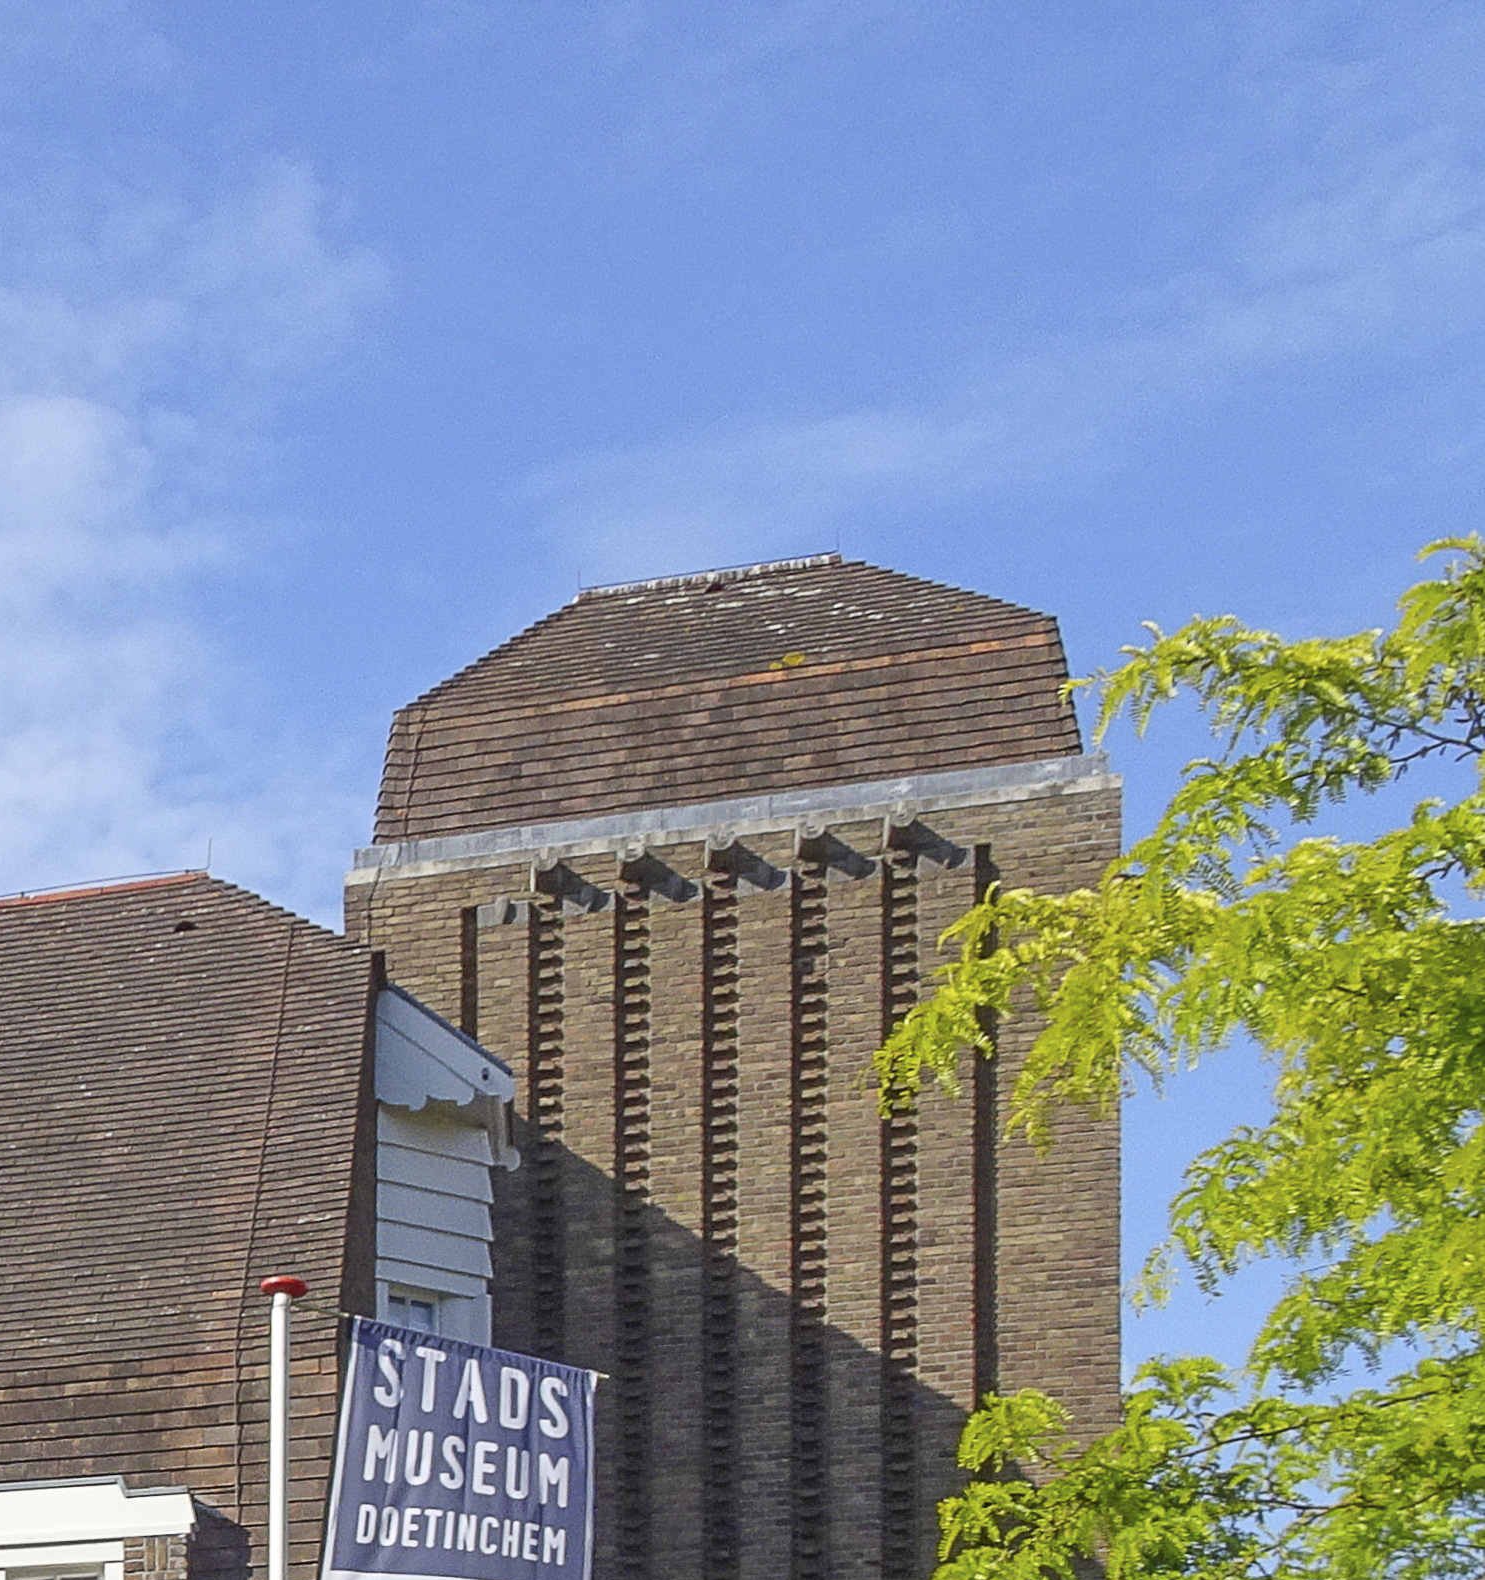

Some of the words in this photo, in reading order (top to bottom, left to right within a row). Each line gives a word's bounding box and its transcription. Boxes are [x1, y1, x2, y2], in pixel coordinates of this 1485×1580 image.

[373, 1338, 569, 1439] STADS
[363, 1424, 569, 1508] MUSEUM
[356, 1503, 567, 1566] DOETINCHEM
